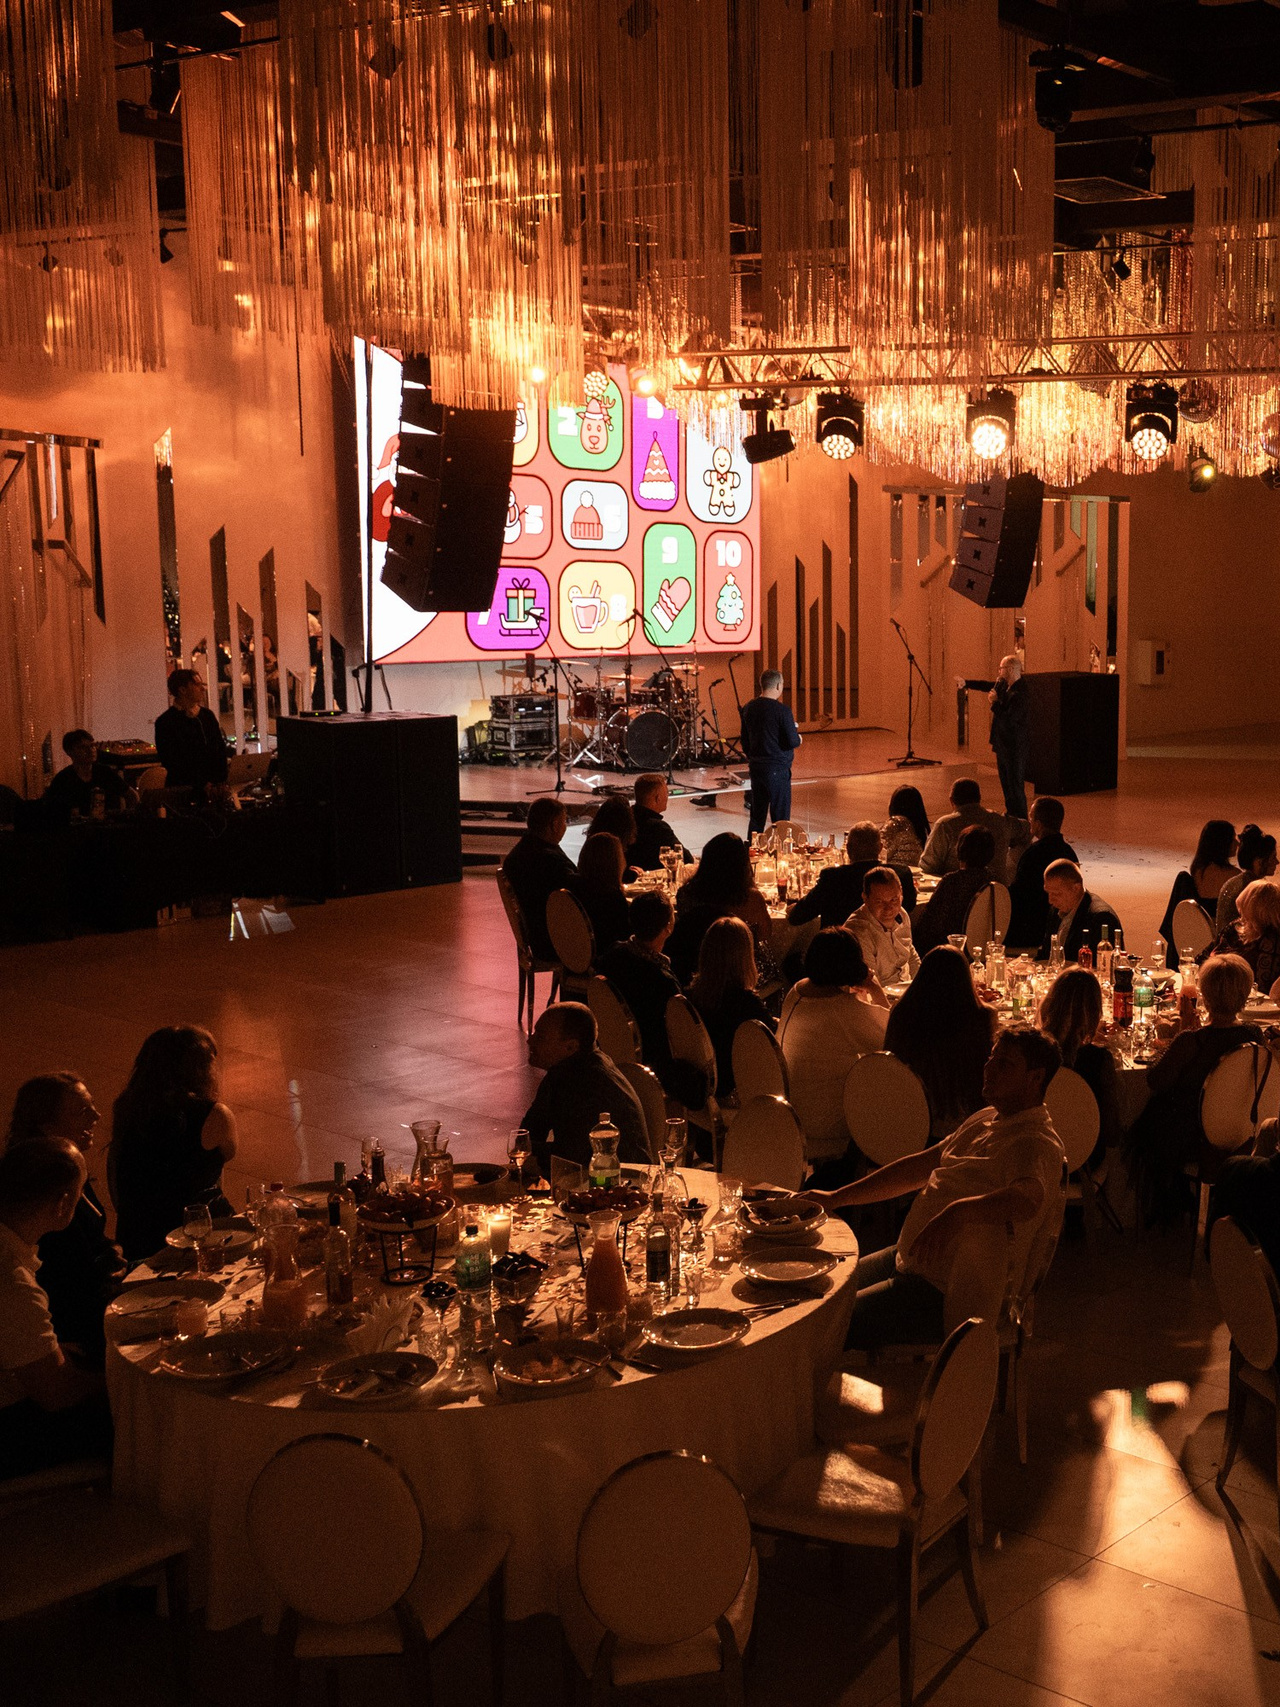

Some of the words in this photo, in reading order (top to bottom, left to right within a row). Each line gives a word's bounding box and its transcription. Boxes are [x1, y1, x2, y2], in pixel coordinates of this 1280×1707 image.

[557, 405, 579, 436] 2
[525, 505, 544, 534] 5
[661, 536, 679, 564] 9
[716, 540, 742, 567] 10
[609, 592, 629, 622] 8
